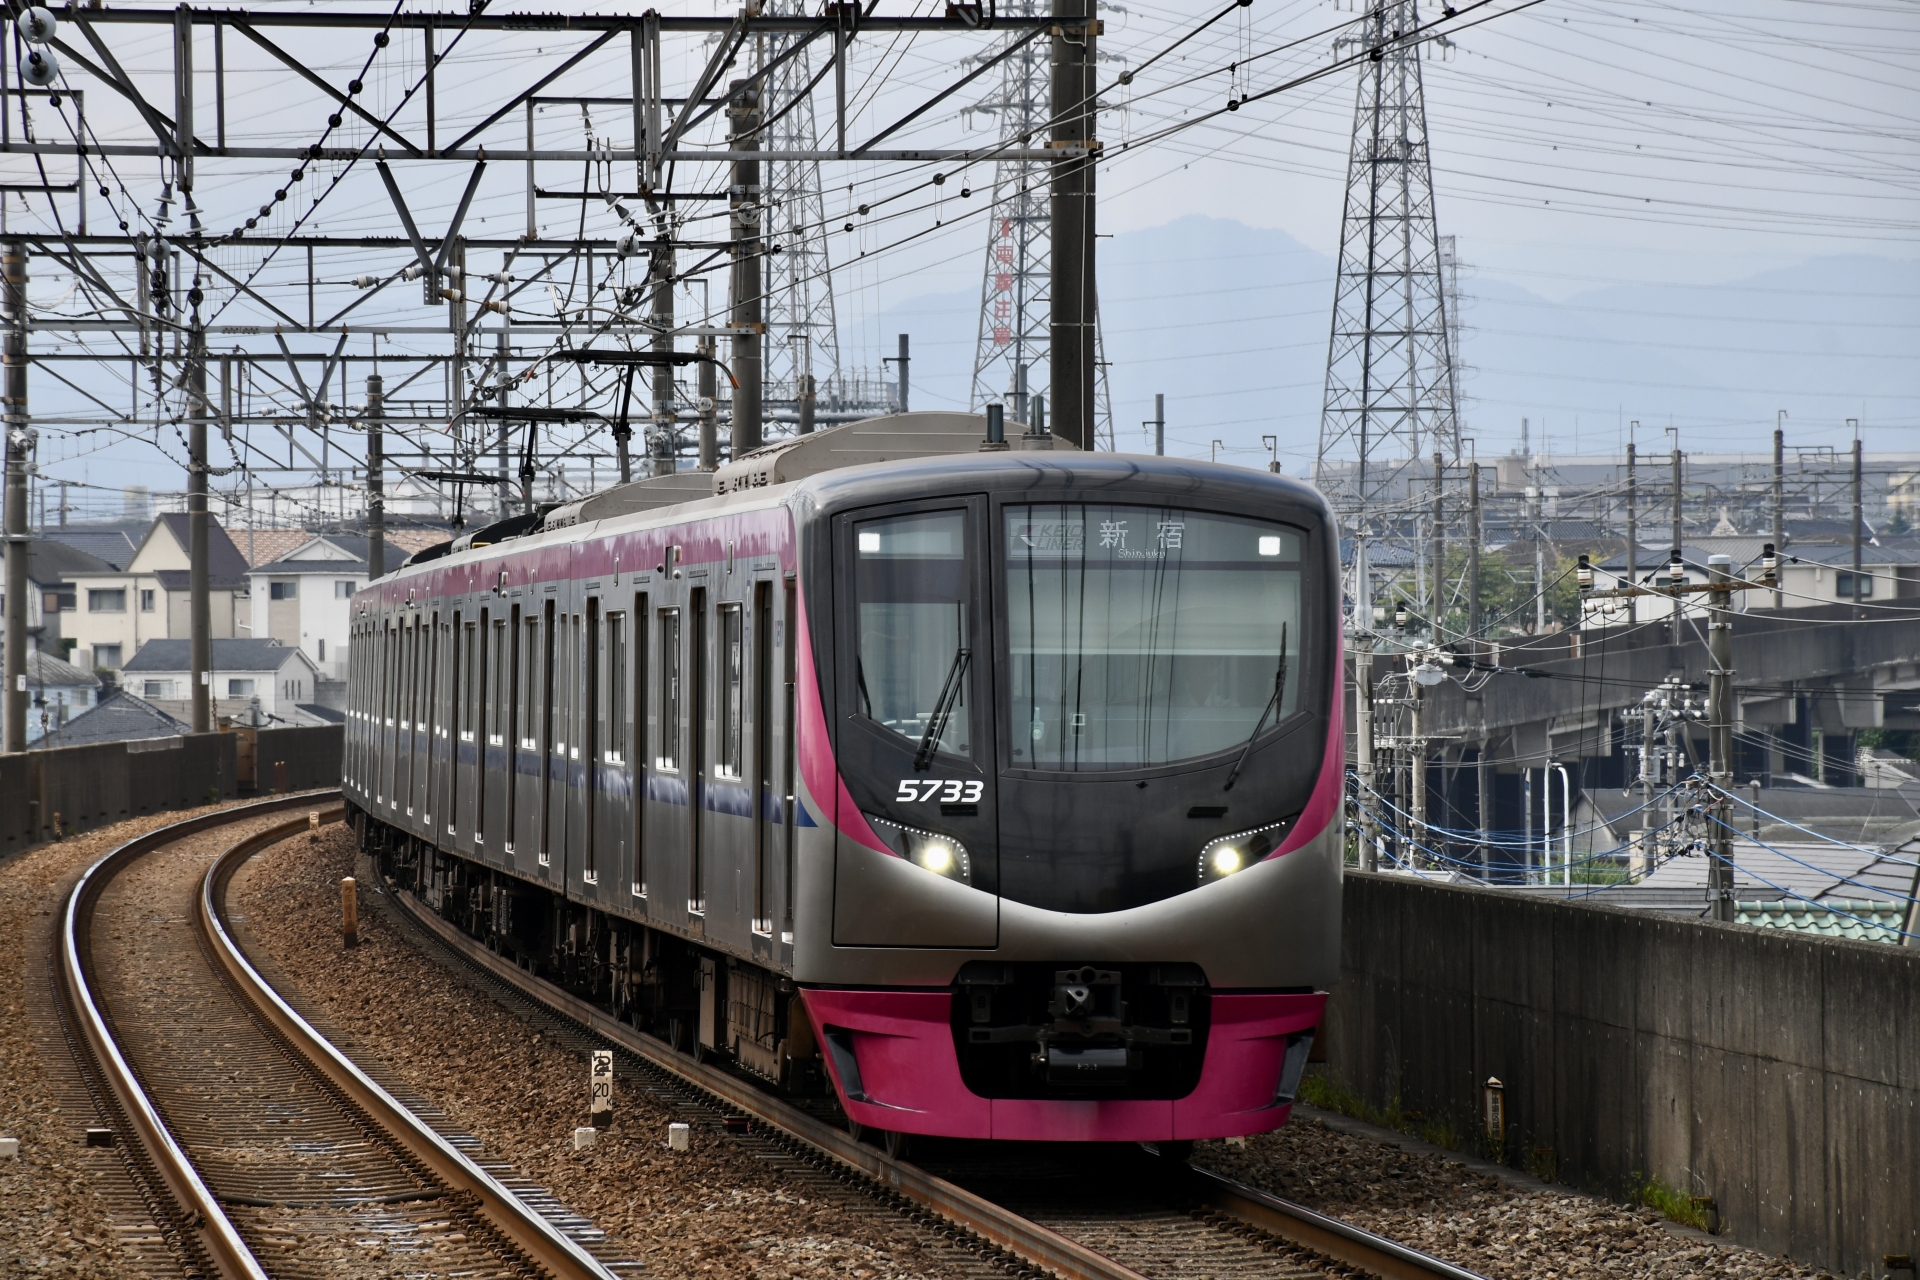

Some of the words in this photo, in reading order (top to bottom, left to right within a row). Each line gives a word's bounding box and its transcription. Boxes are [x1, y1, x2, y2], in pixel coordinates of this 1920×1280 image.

[1099, 519, 1185, 548] 新宿
[895, 779, 984, 803] 5733
[310, 813, 318, 821] 3
[594, 1082, 609, 1098] 20
